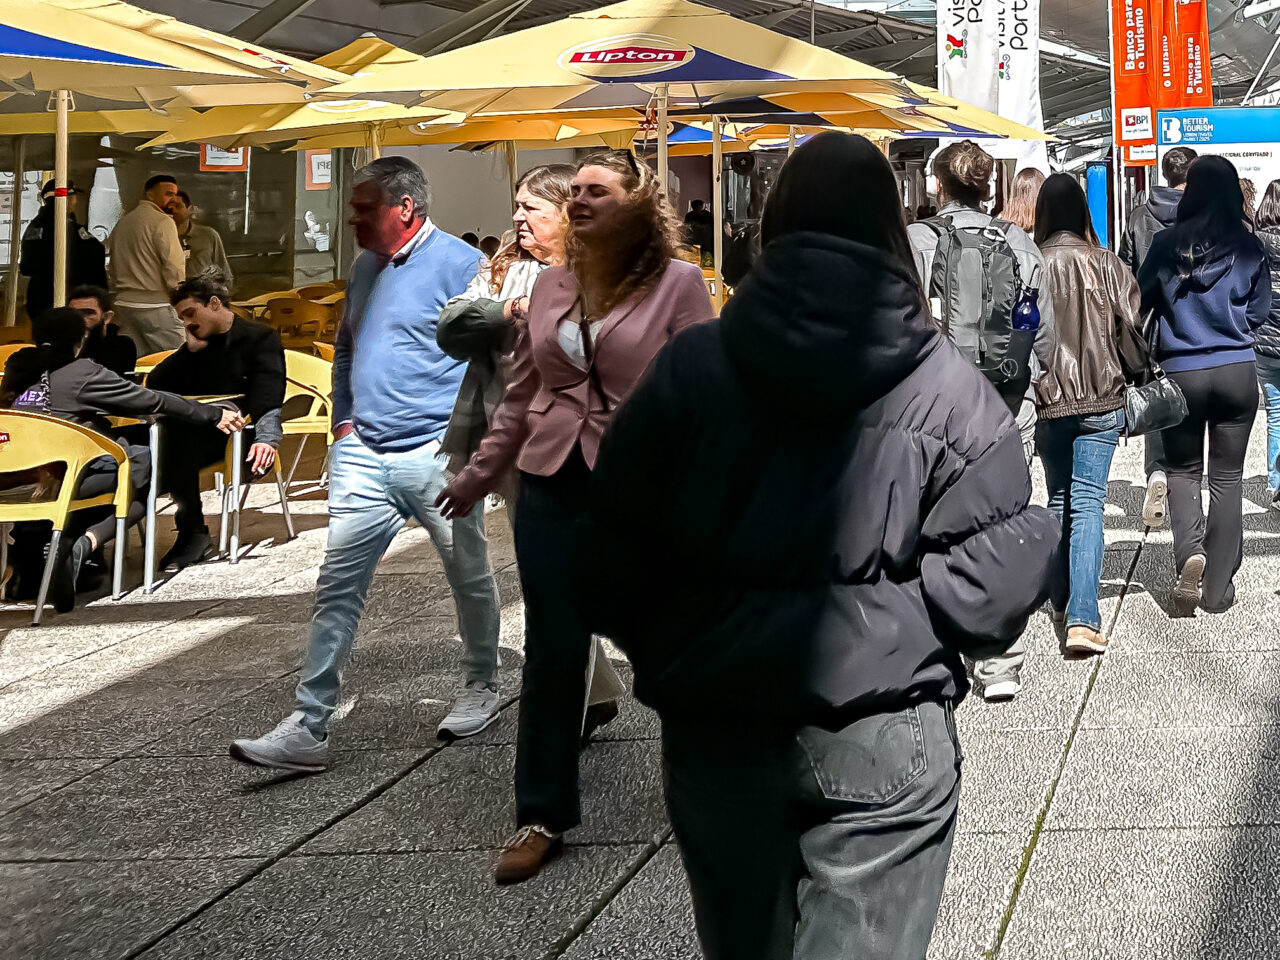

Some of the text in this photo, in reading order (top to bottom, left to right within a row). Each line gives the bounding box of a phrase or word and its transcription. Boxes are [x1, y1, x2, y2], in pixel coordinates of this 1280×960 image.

[1134, 7, 1145, 70] o Turismo
[580, 50, 675, 63] Lipton
[1124, 30, 1136, 71] Banco
[1186, 62, 1194, 94] Banco
[1193, 45, 1203, 94] o Turismo
[1135, 115, 1149, 125] BPI
[1182, 117, 1209, 125] BETTER
[1183, 124, 1214, 132] TOURISM
